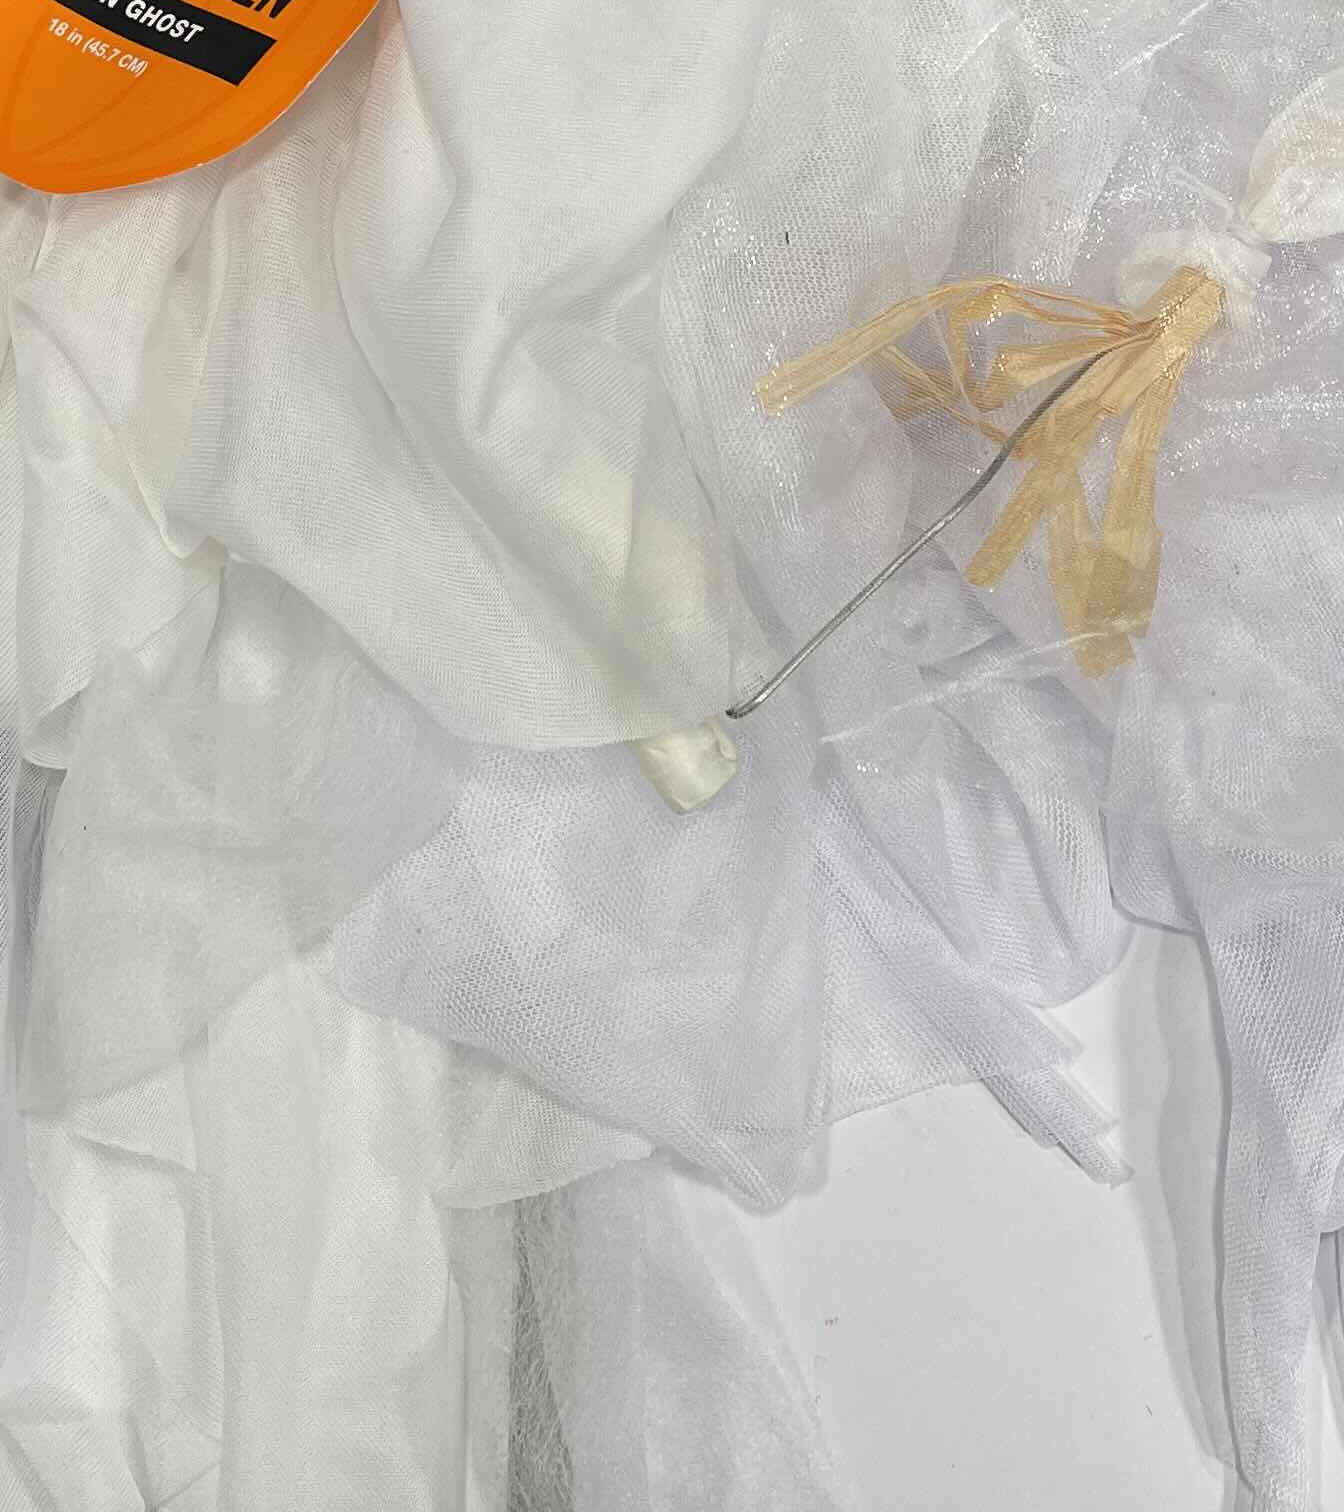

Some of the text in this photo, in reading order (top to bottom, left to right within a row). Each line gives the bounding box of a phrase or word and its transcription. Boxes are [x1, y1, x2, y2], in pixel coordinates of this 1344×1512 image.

[124, 0, 205, 42] GHOST
[48, 18, 149, 79] 18 in (45.7 CM)
